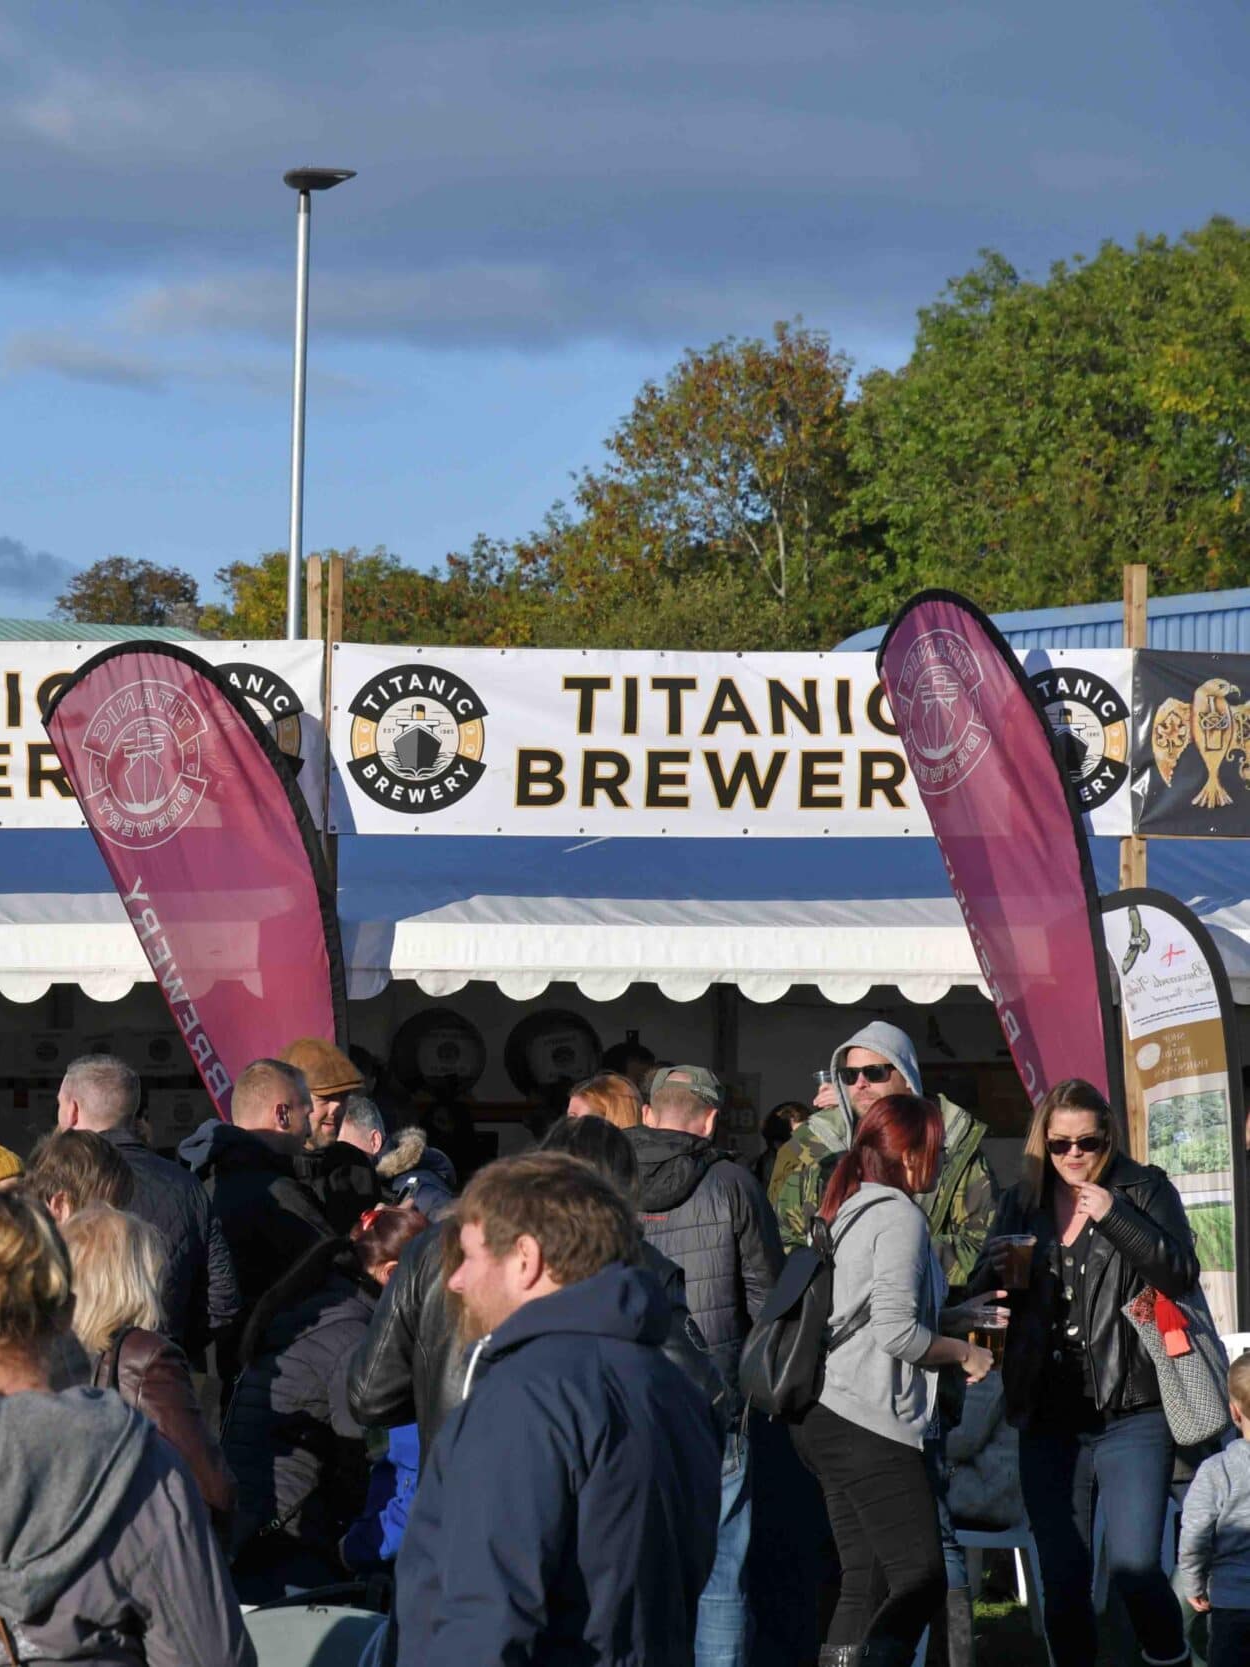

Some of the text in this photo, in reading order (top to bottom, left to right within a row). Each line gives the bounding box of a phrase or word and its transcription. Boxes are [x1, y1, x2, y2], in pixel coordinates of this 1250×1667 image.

[229, 672, 289, 712] ANIC
[362, 673, 474, 715] TITANIC
[1037, 677, 1117, 717] TANIC
[362, 763, 470, 803] BREWERY
[514, 747, 910, 810] BREWER
